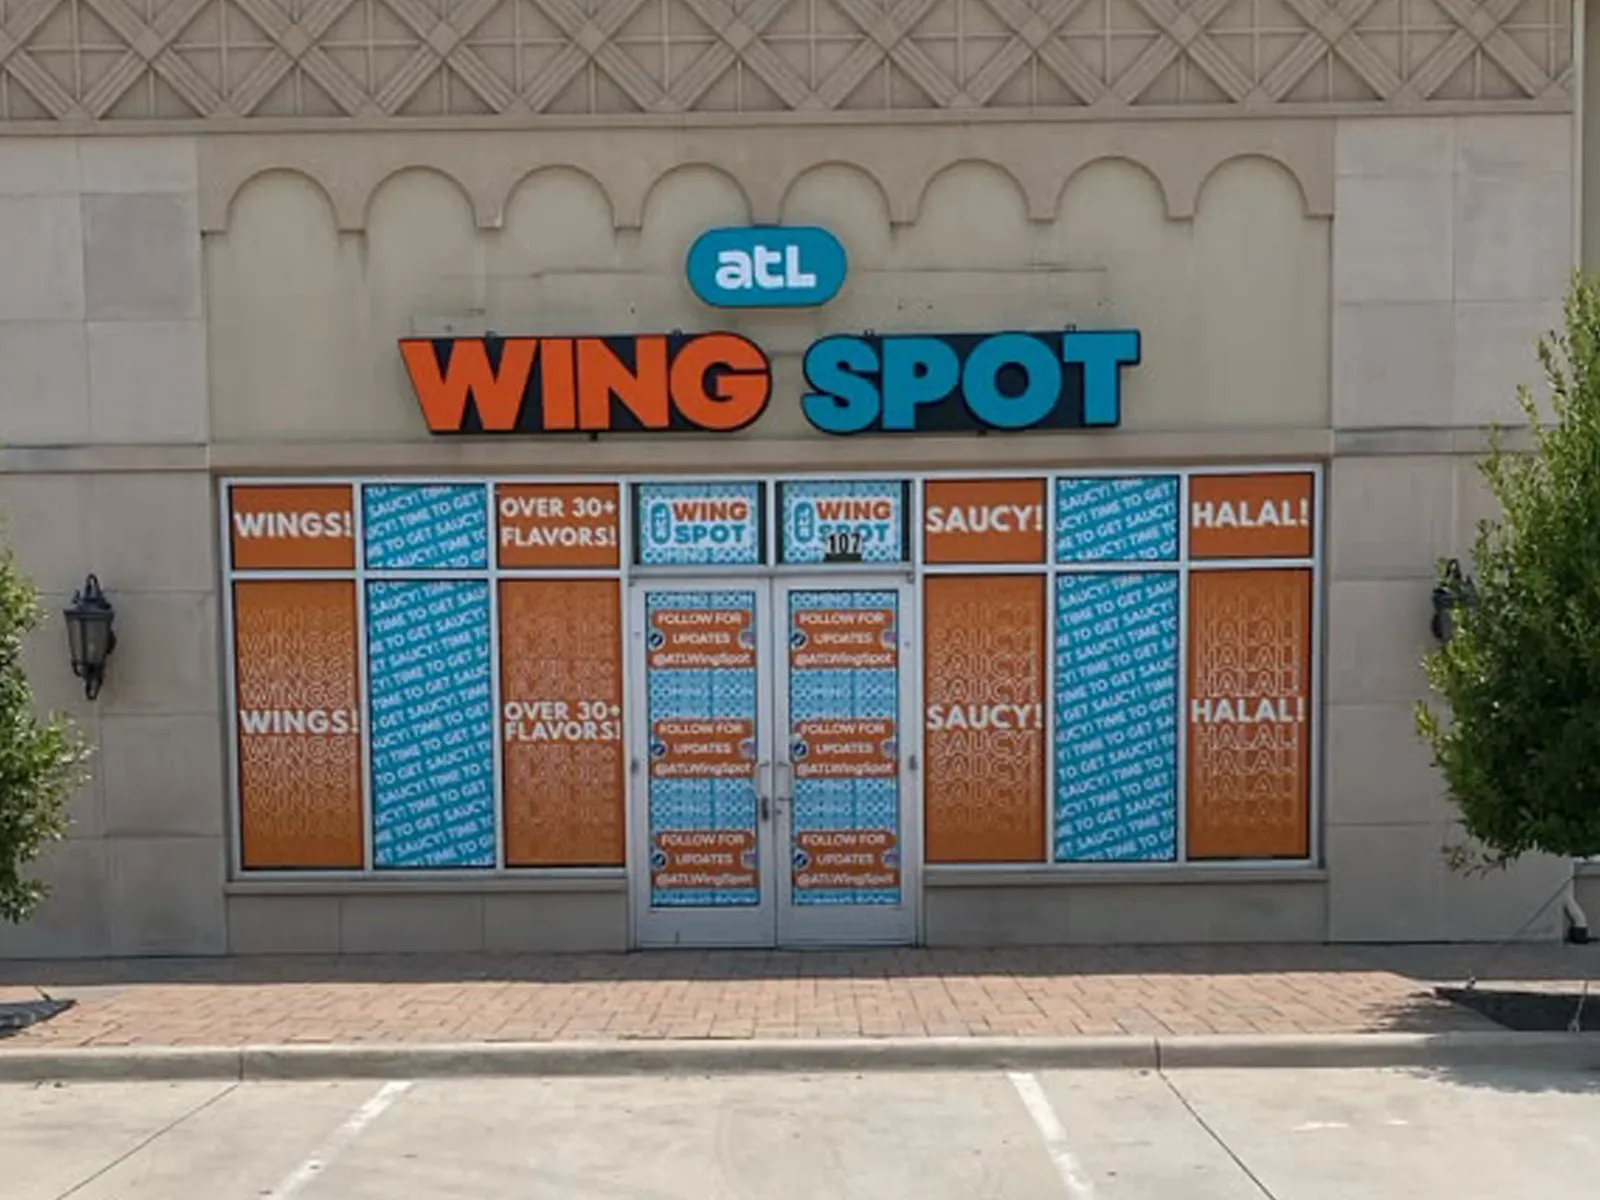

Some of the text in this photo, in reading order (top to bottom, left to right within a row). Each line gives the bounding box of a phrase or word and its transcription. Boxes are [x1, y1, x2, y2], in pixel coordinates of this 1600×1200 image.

[399, 330, 1139, 432] WING SPOT
[431, 501, 451, 516] TO
[453, 491, 478, 509] GET
[1122, 493, 1142, 509] TO
[1144, 483, 1169, 502] GET
[500, 496, 616, 517] OVER 30+
[672, 502, 748, 520] WING
[816, 501, 891, 520] WING
[1192, 500, 1309, 528] HALAL!
[234, 512, 352, 539] WINGS!
[926, 505, 1044, 532] SAUCY!
[384, 527, 432, 552] TO GET
[501, 526, 616, 548] FLAVORS!
[674, 525, 746, 543] SPOT
[1074, 529, 1095, 545] TO
[1096, 519, 1122, 537] GET
[829, 533, 861, 554] 107
[407, 606, 427, 622] TO
[428, 597, 454, 615] GET
[1095, 600, 1115, 615] TO
[658, 612, 741, 623] FOLLOW FOR
[800, 612, 884, 623] FOLLOW FOR
[384, 633, 405, 649] TO
[406, 623, 432, 641] GET
[1072, 627, 1092, 643] TO
[425, 659, 445, 675] TO
[1111, 652, 1131, 667] TO
[404, 685, 424, 700] TO
[1088, 679, 1108, 694] TO
[443, 710, 463, 726] TO
[504, 701, 620, 720] OVER 30+
[926, 704, 1043, 729] SAUCY!
[1128, 704, 1147, 720] TO
[1191, 699, 1307, 723] HALAL!
[240, 709, 360, 733] WINGS!
[660, 723, 743, 734] FOLLOW FOR
[800, 723, 885, 734] FOLLOW FOR
[505, 721, 621, 740] FLAVORS!
[1104, 731, 1124, 745] TO
[421, 738, 441, 753] TO
[460, 763, 481, 778] TO
[1144, 755, 1164, 770] TO
[440, 788, 460, 803] TO
[1121, 782, 1141, 798] TO
[394, 822, 413, 837] TO
[1075, 816, 1094, 832] TO
[661, 833, 745, 845] FOLLOW FOR
[802, 832, 885, 845] FOLLOW FOR
[1137, 833, 1157, 848] TO
[456, 840, 477, 856] TO
